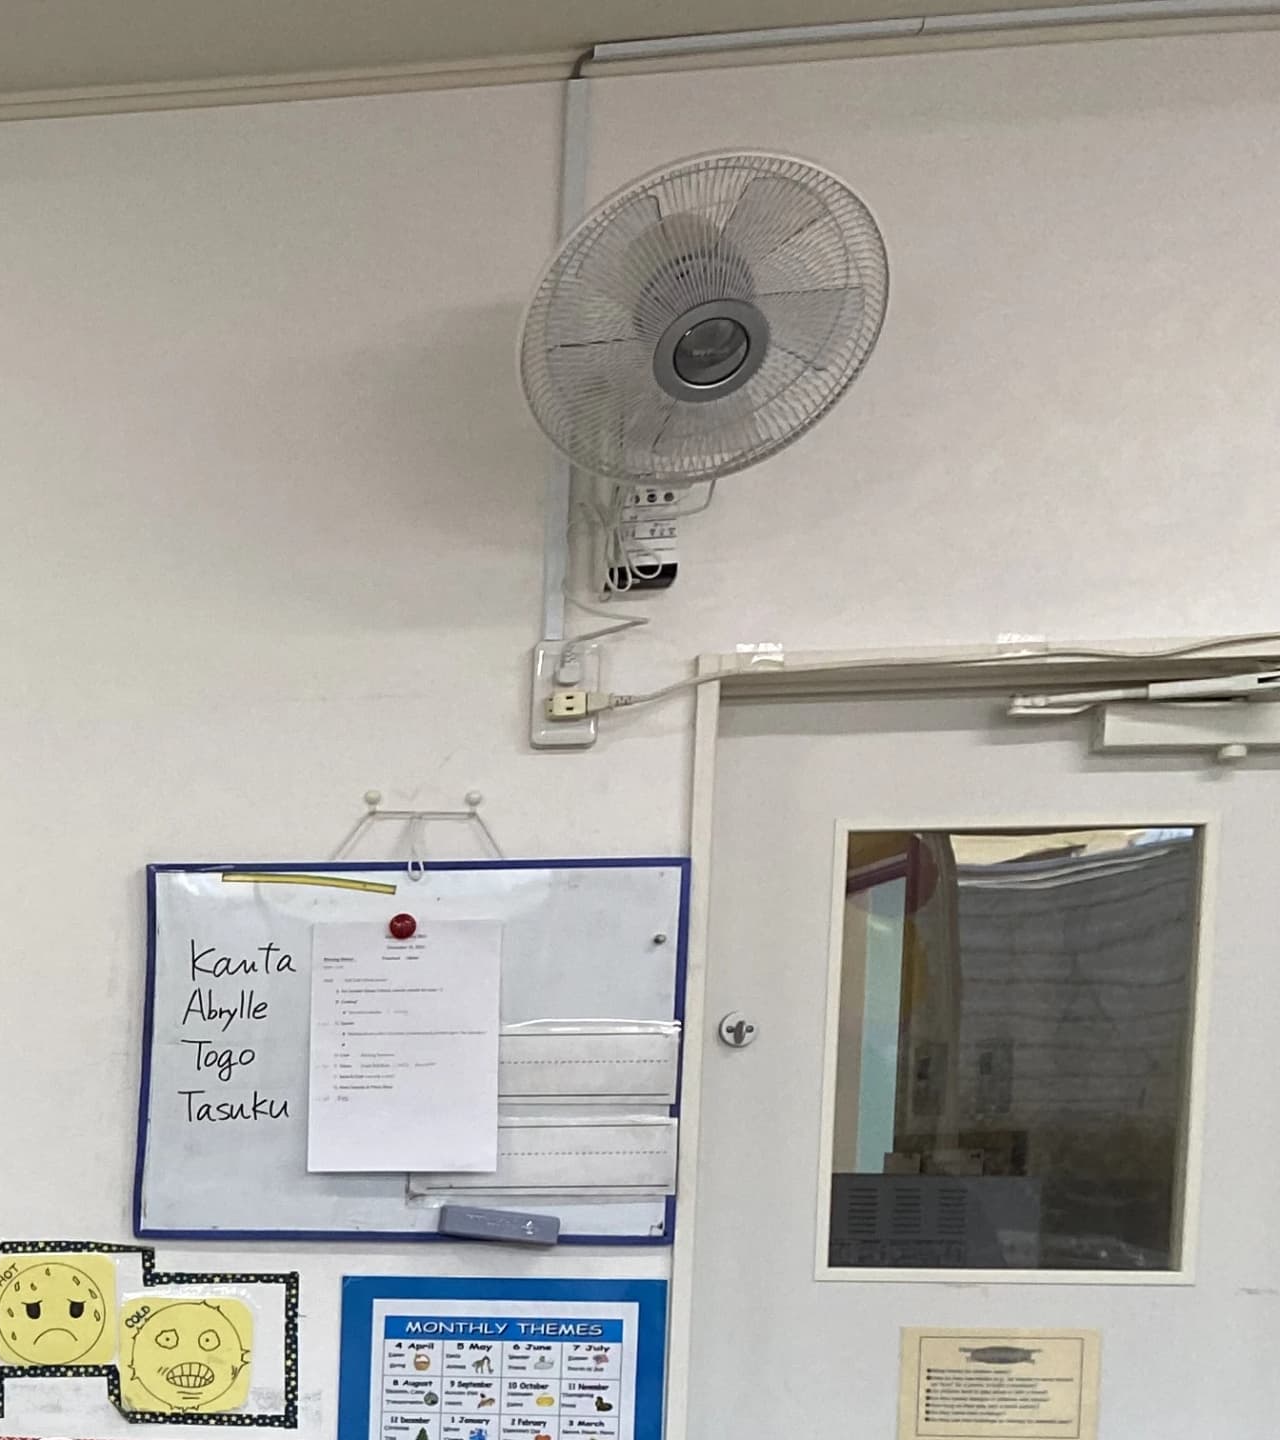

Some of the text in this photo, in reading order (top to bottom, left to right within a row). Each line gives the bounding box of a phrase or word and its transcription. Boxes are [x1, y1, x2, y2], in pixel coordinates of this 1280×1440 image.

[183, 988, 269, 1033] Abrylle
[181, 1038, 256, 1081] Togo
[178, 1090, 290, 1123] Tasuku
[124, 1304, 152, 1330] COLD
[406, 1321, 602, 1336] MONTHLY THEMES
